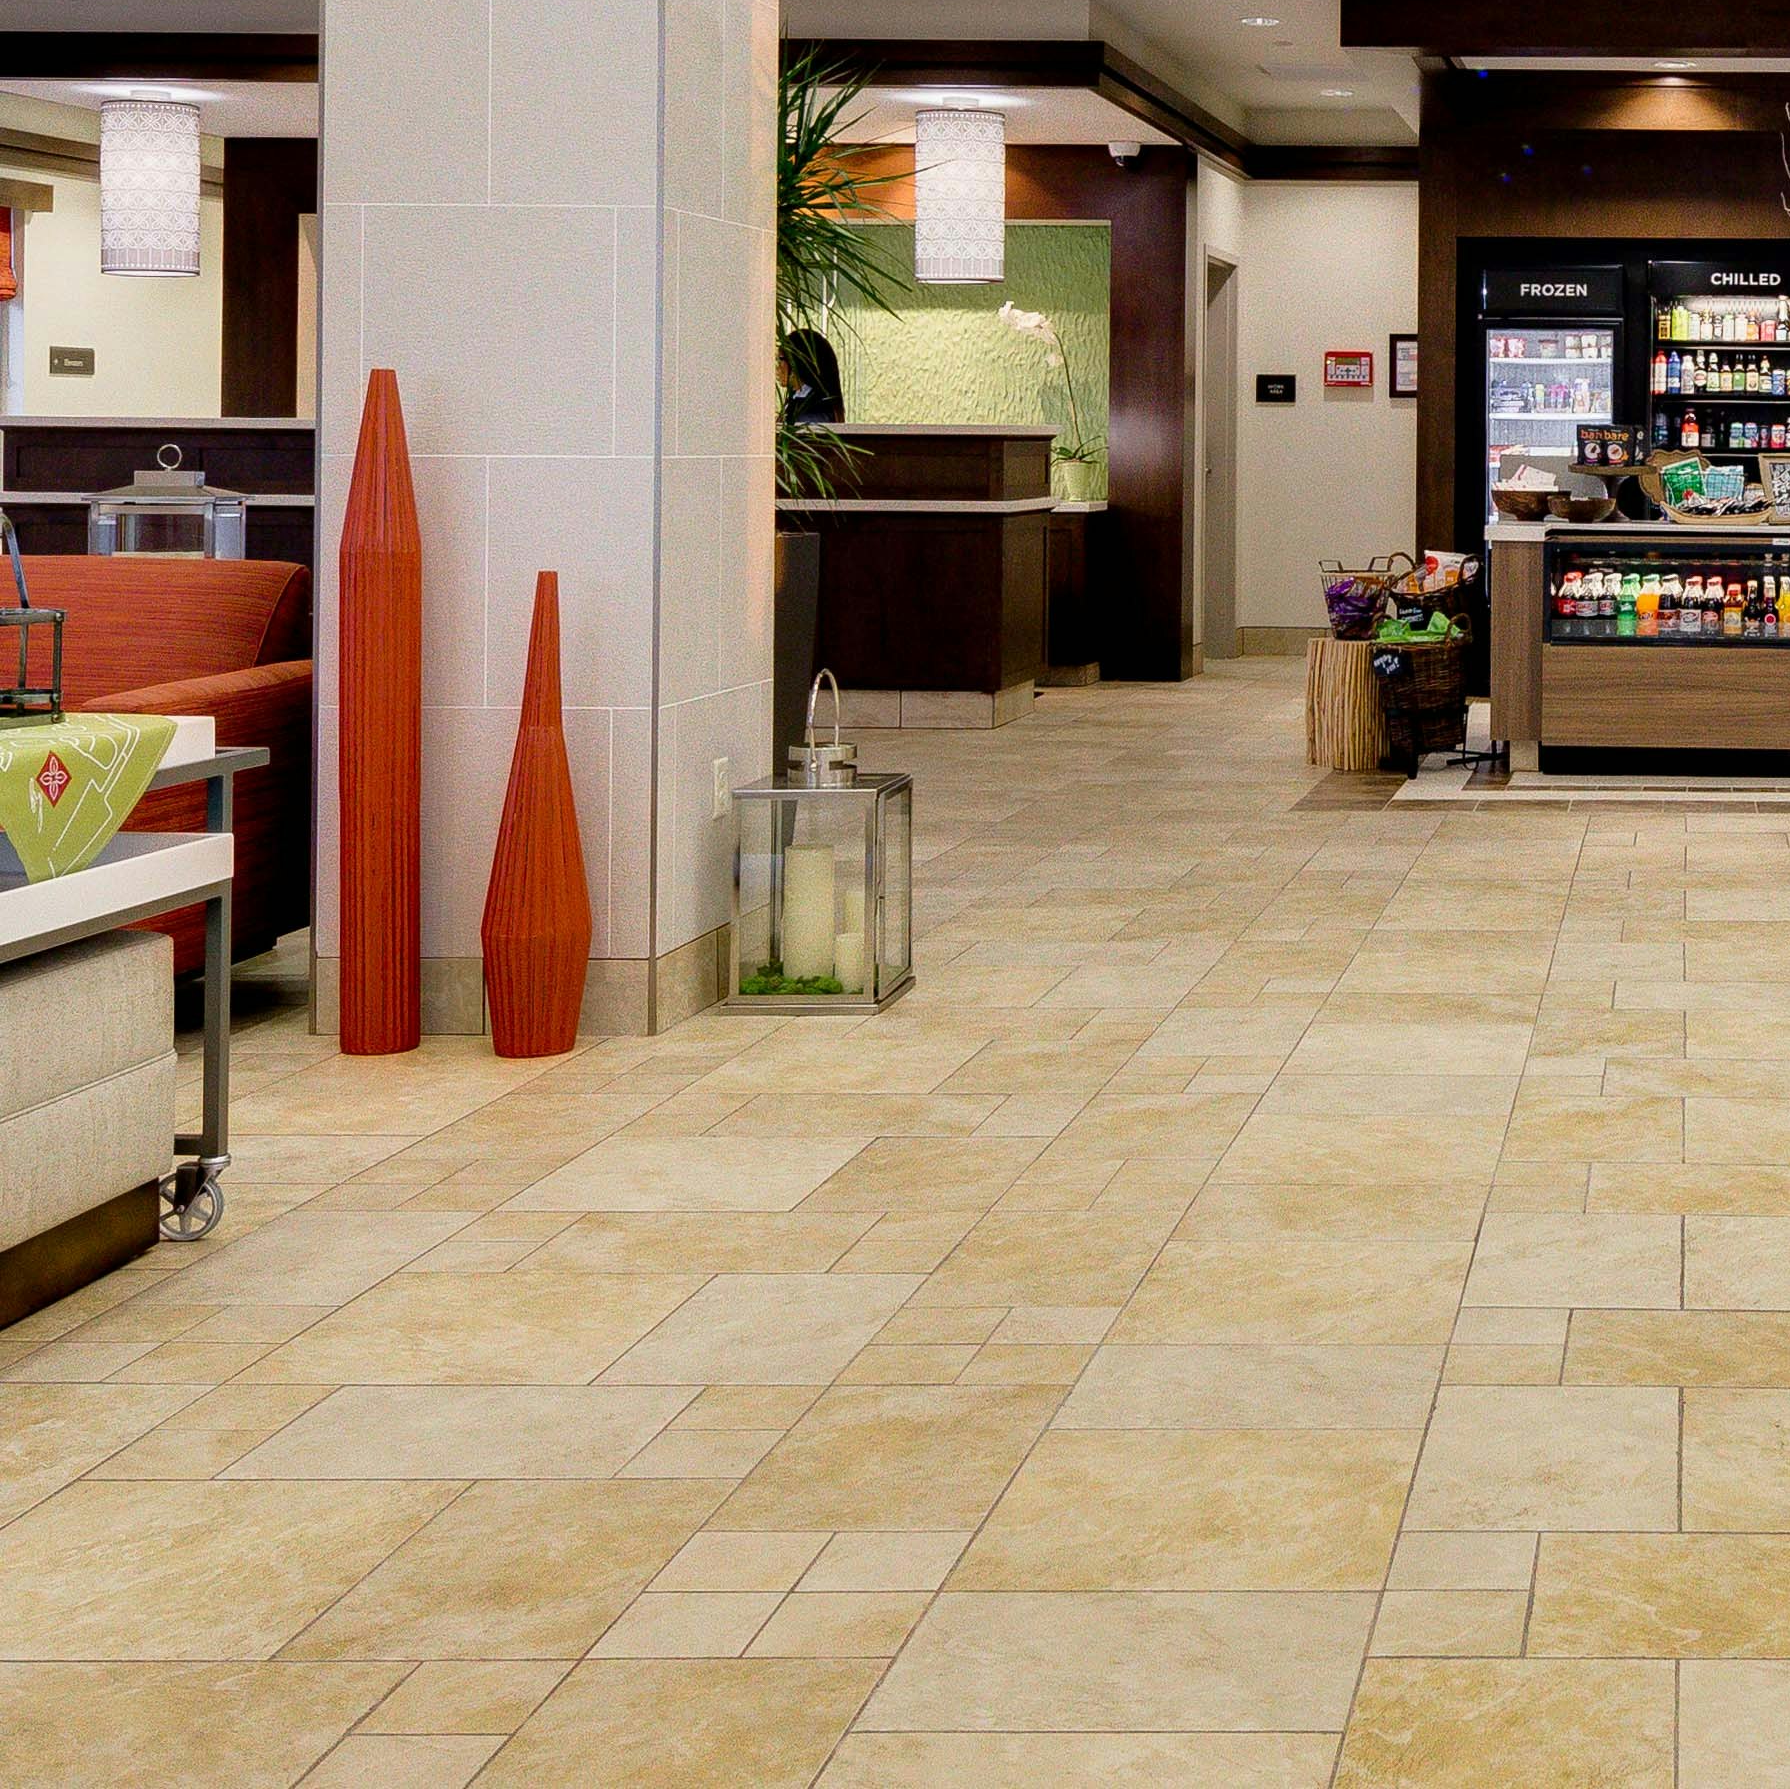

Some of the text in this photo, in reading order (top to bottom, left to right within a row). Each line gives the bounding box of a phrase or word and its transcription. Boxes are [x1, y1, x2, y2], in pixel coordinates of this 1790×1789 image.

[1710, 272, 1782, 287] CHILLED
[1519, 283, 1588, 298] FROZEN
[1604, 429, 1630, 442] bare
